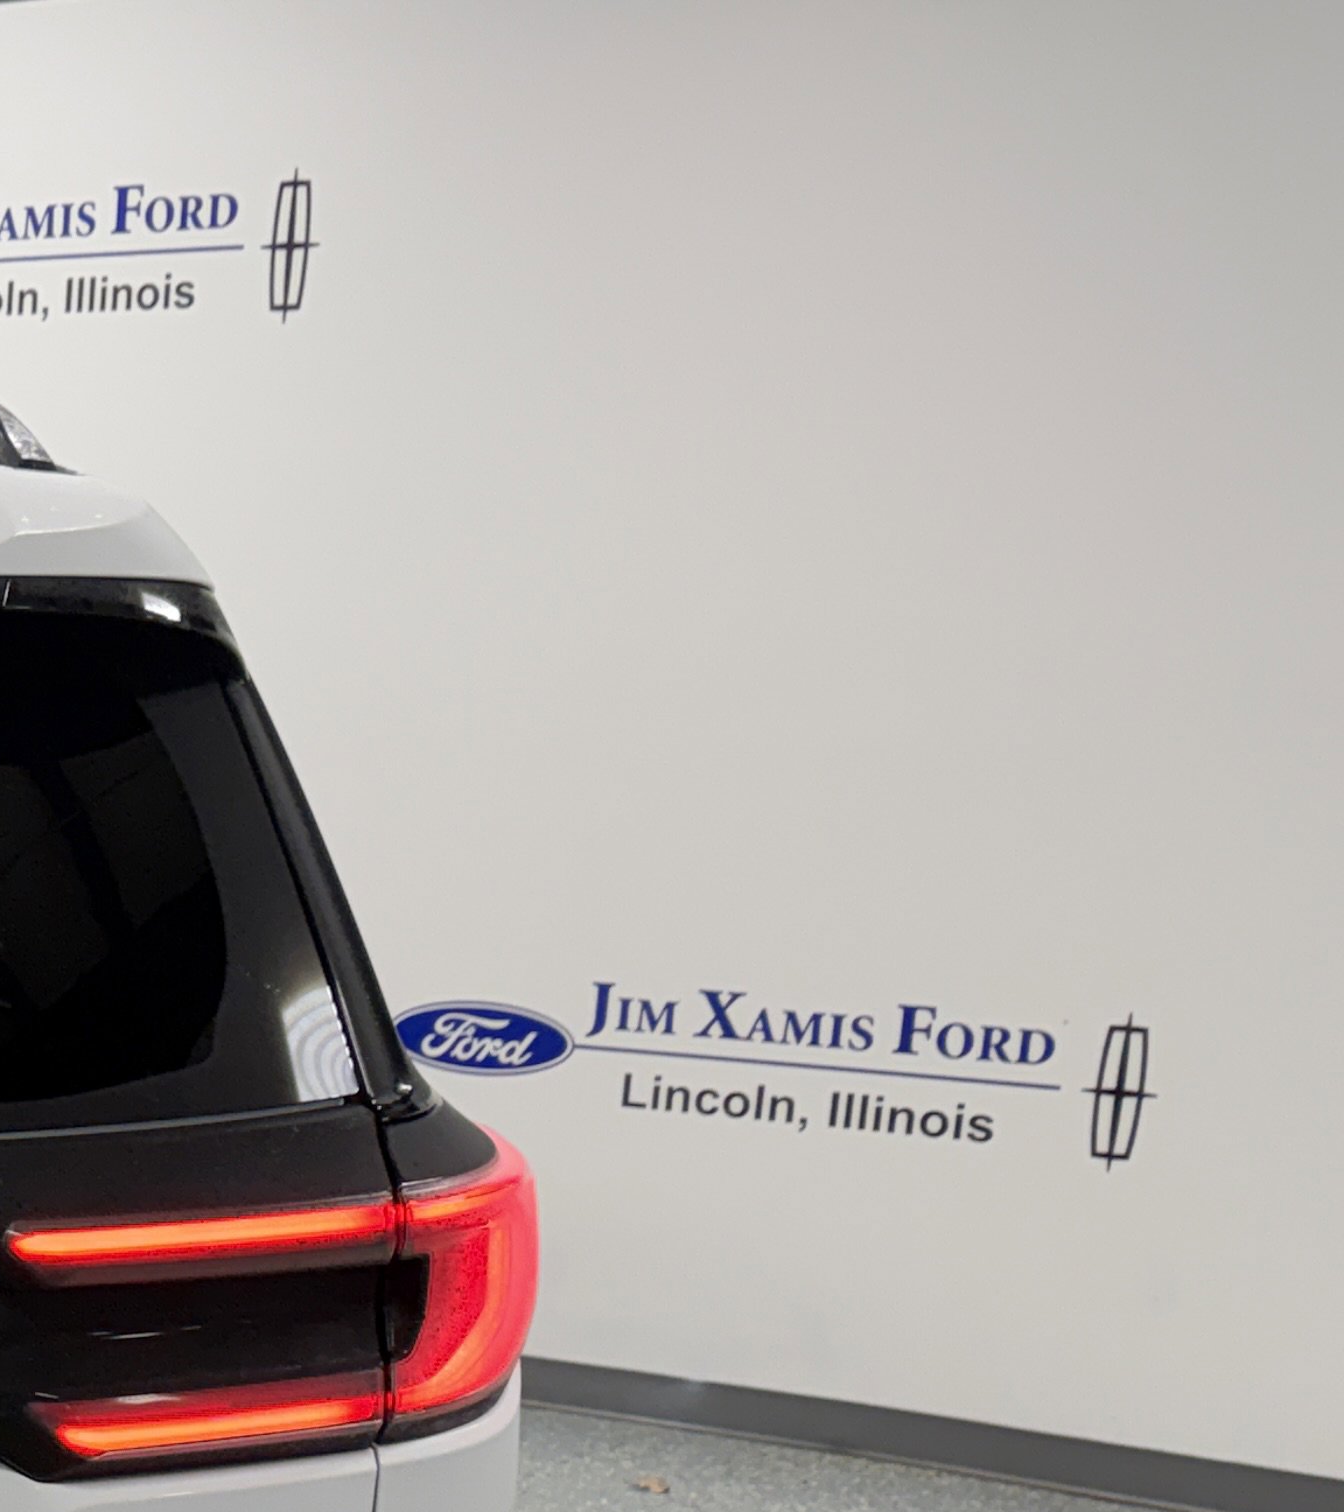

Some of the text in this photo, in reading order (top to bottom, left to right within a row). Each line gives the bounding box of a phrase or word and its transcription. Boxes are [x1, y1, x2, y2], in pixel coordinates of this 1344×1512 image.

[65, 273, 195, 314] Illinois
[421, 1012, 537, 1067] Ford
[621, 1073, 994, 1143] Lincoln, Illinois
